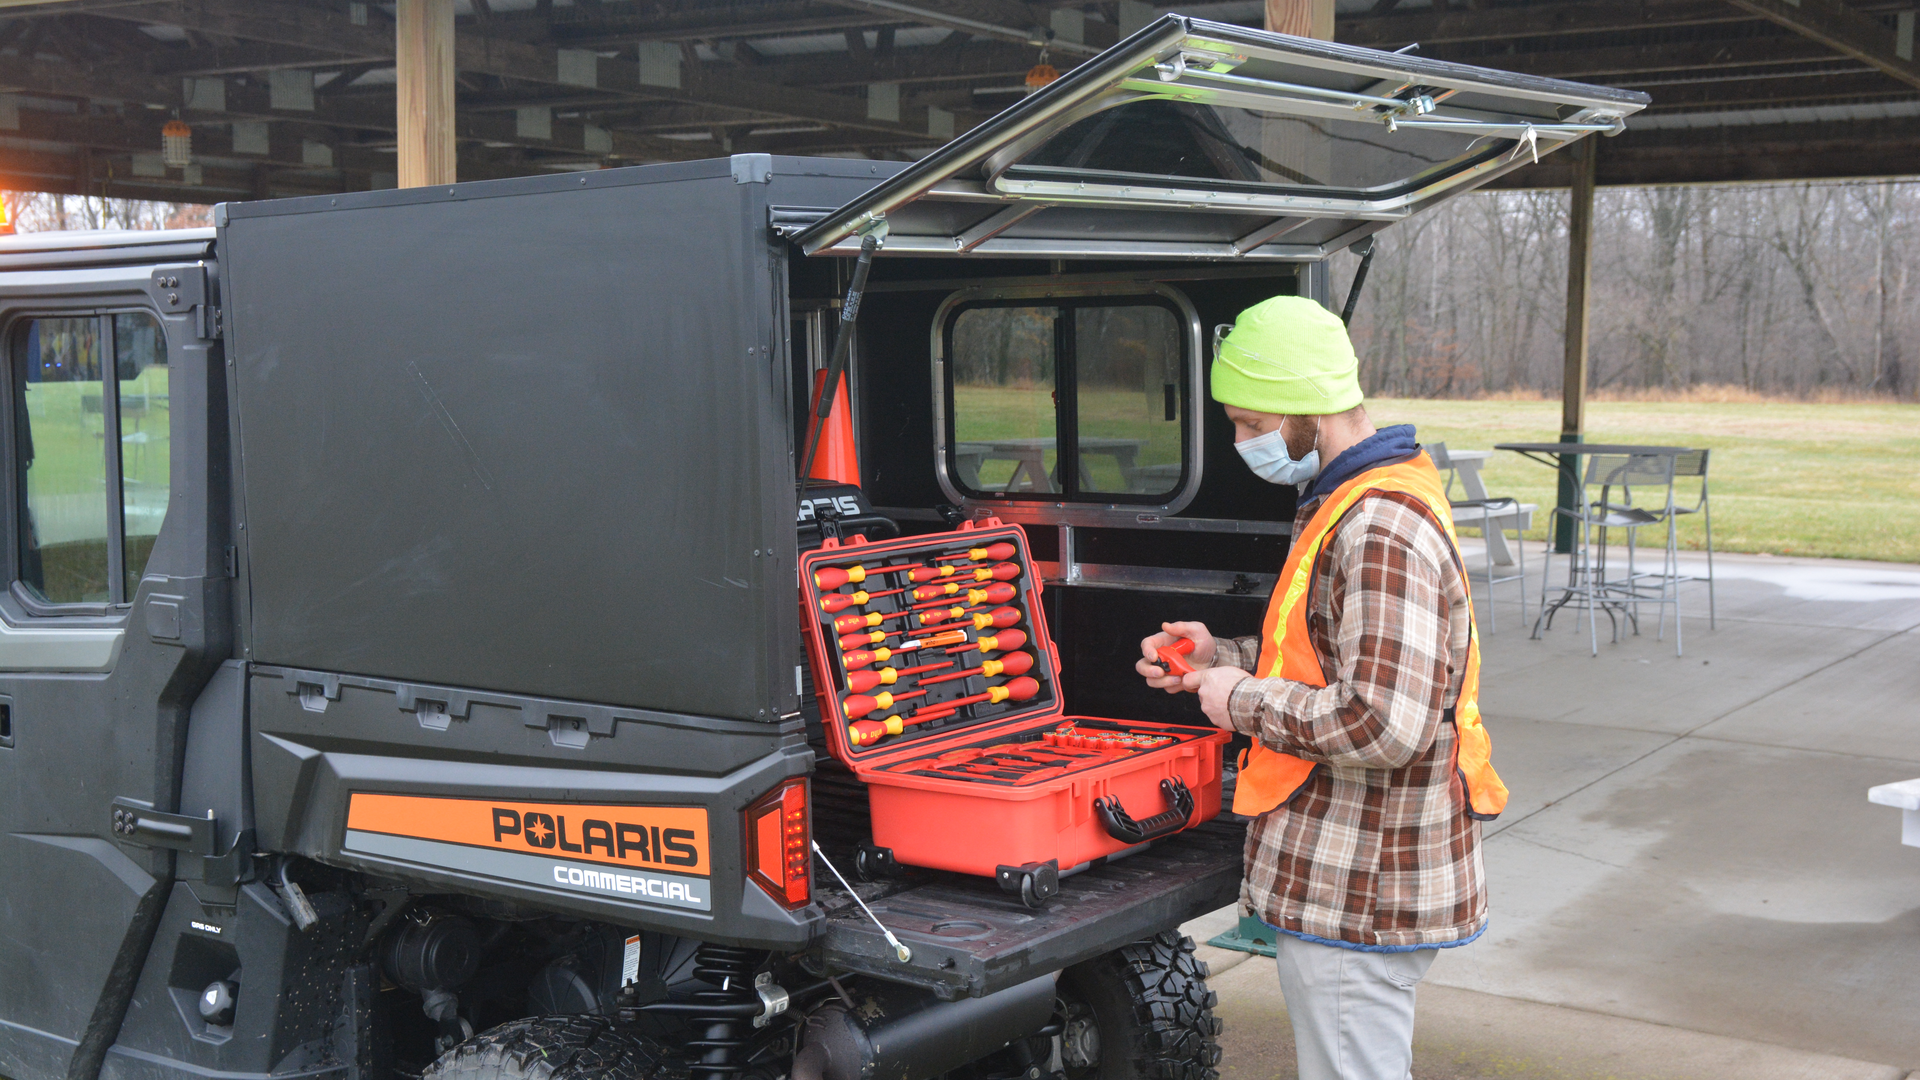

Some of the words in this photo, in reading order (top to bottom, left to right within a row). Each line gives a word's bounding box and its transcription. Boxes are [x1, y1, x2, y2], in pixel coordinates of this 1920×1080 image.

[492, 807, 698, 868] POLARIS
[553, 865, 701, 903] COMMERCIAL
[205, 924, 221, 934] ONLY
